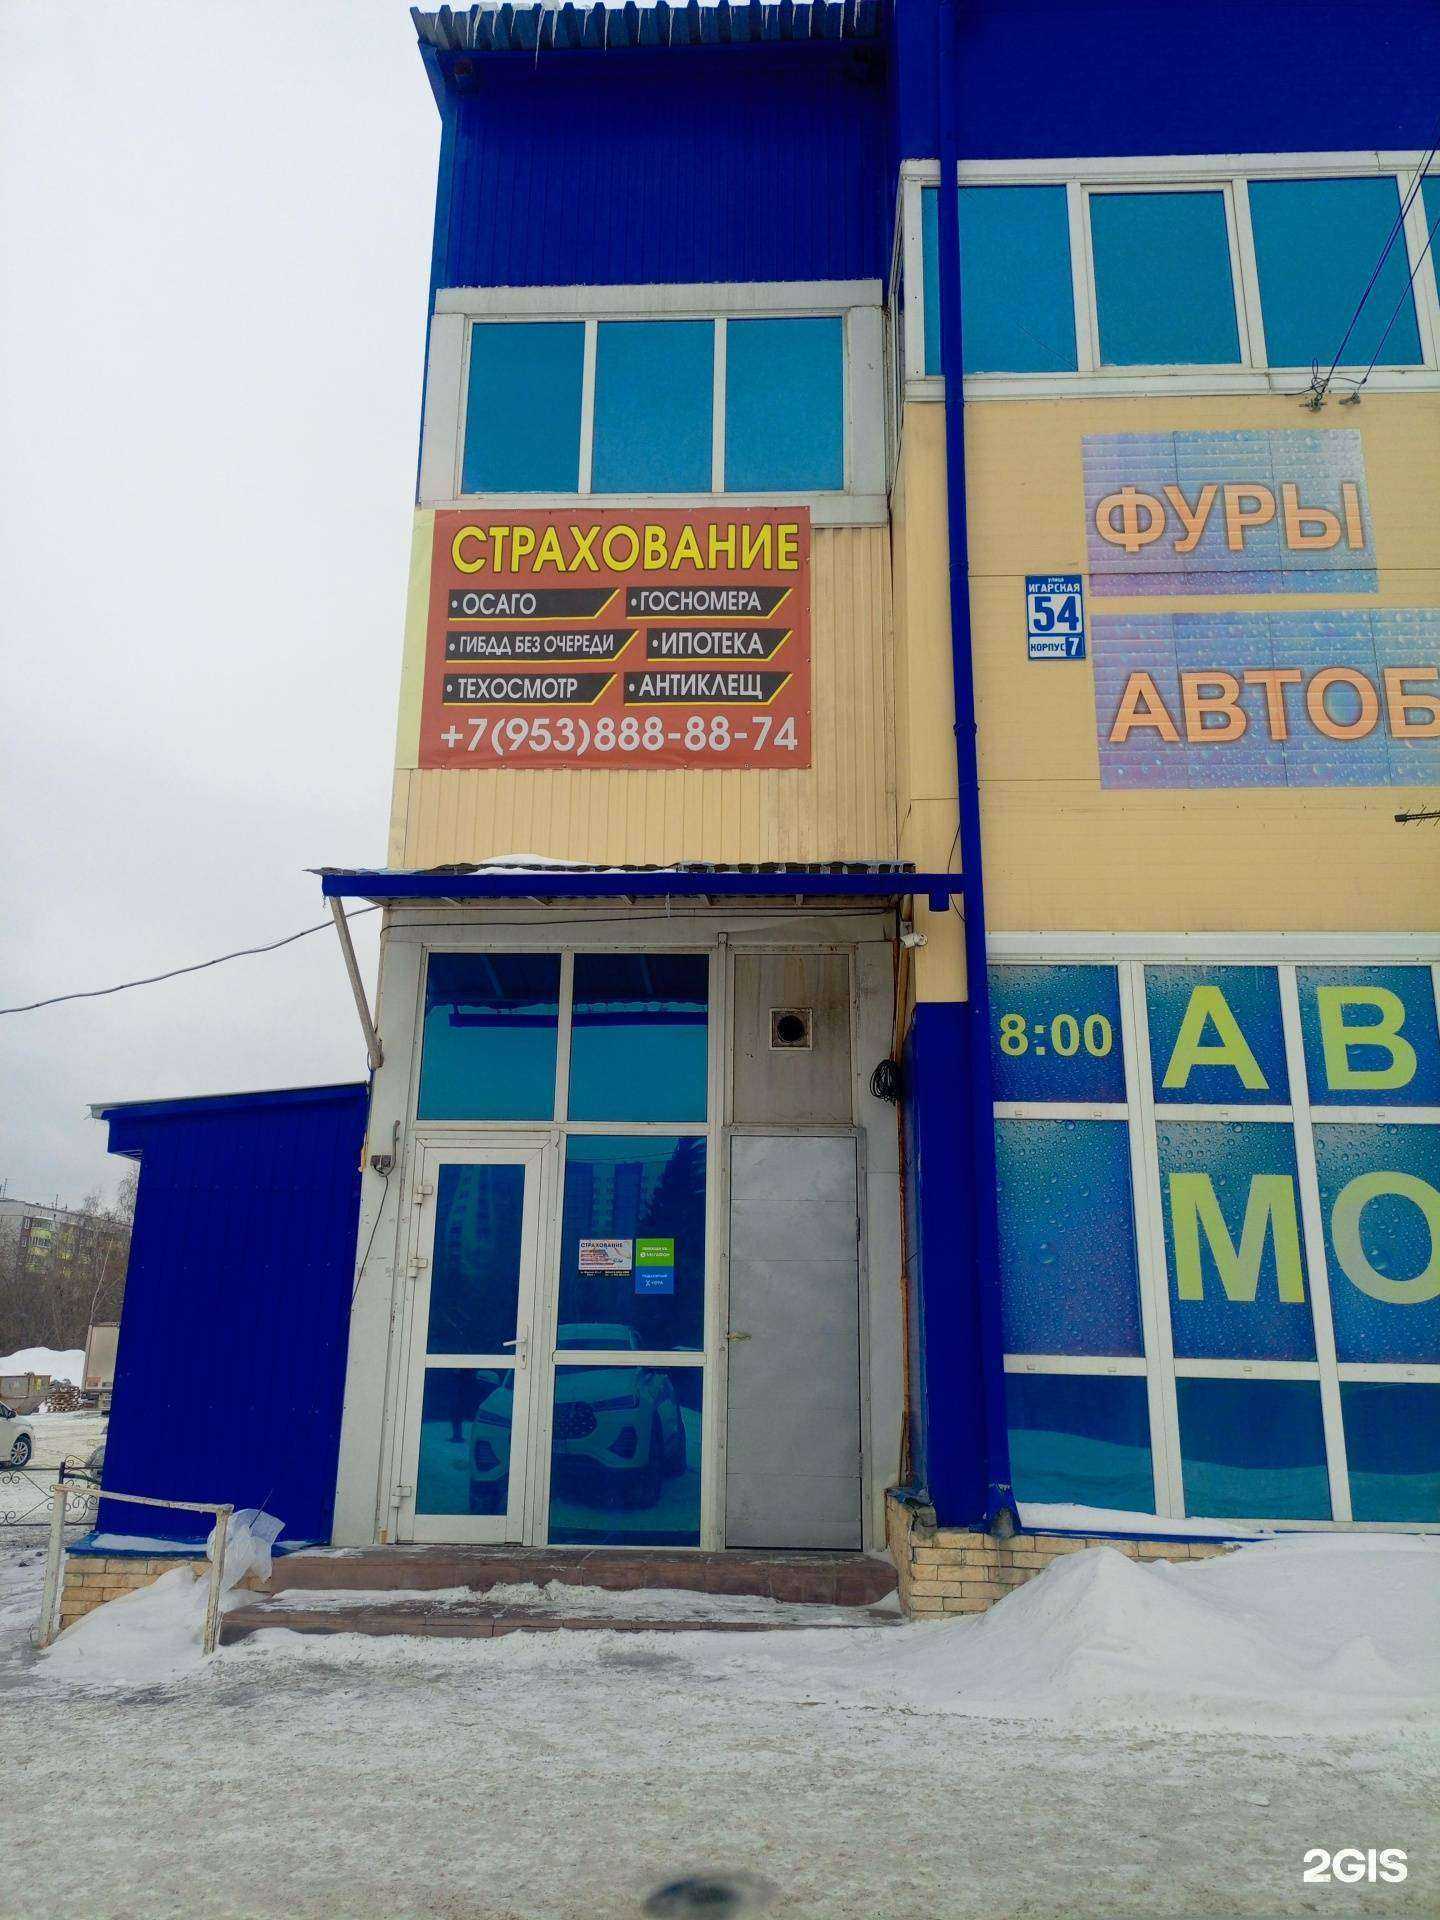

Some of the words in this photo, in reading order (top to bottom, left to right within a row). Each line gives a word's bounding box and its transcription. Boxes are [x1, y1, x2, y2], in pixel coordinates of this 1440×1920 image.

[1094, 481, 1366, 553] ФУРЫ
[450, 523, 800, 574] СТРАХОВАНИЕ
[1028, 583, 1080, 593] ИГАРСКАЯ
[462, 592, 537, 615] ОСАГО
[639, 590, 762, 612] ГОСНОМЕРА
[1033, 595, 1080, 632] 54
[458, 635, 512, 656] ГИБДД
[514, 635, 541, 654] БЕЗ
[543, 634, 614, 654] ОЧЕРЕДИ
[660, 631, 764, 655] ИПОТЕКА
[1030, 643, 1065, 652] КОРПУС
[1069, 637, 1080, 656] 7
[457, 677, 578, 699] ТЕХОСМОТР
[638, 673, 763, 700] АНТИКЛЕЩ
[1108, 666, 1440, 744] АВТОБ
[440, 716, 798, 757] +7(953)888-88-74
[999, 1013, 1113, 1057] 8:00
